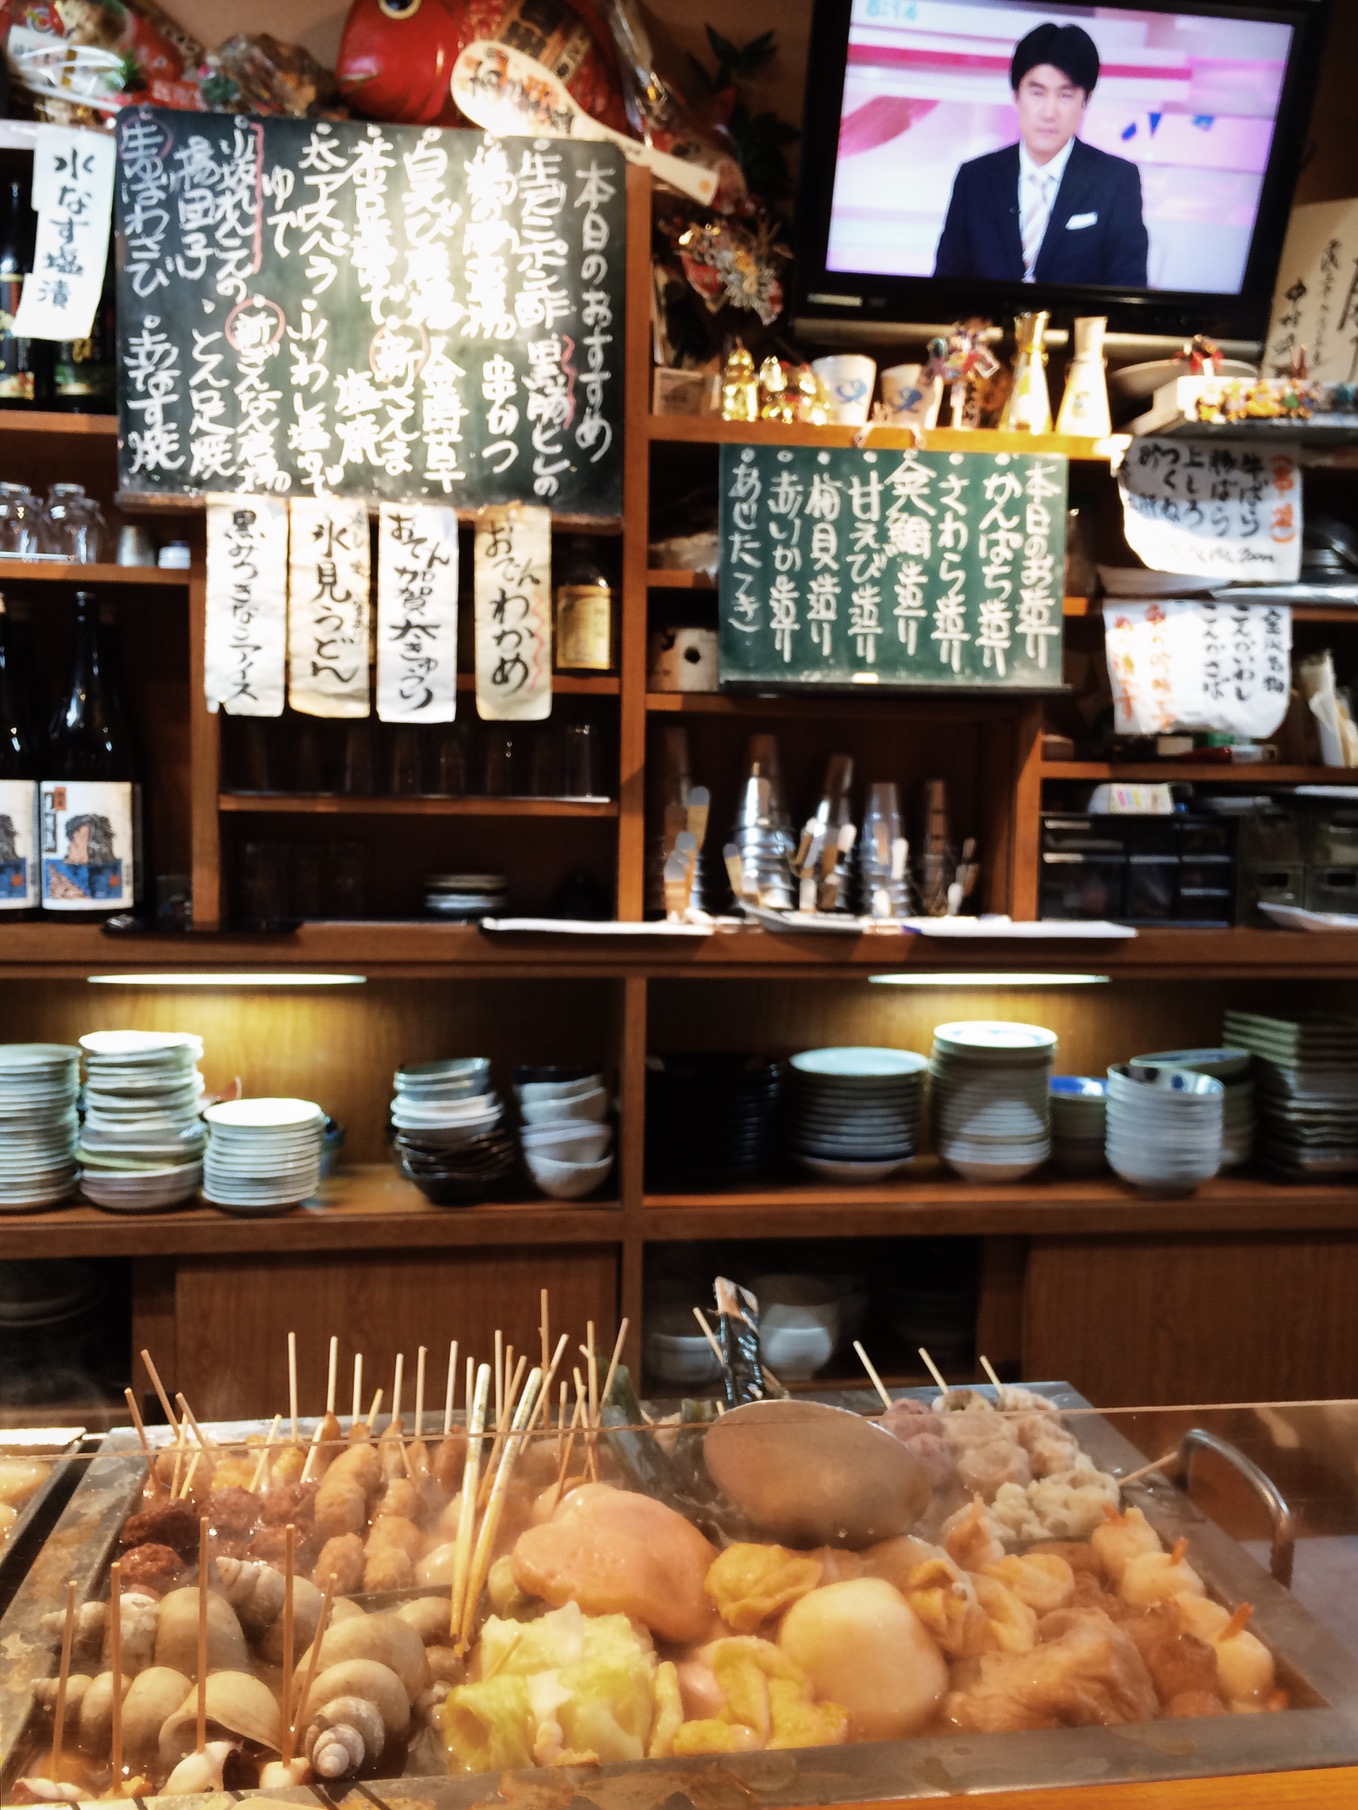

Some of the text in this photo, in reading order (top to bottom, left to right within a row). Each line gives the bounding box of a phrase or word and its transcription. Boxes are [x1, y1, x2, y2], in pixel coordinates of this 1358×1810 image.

[574, 160, 617, 463] 本日のおすすめ
[481, 354, 520, 474] 串かつ
[310, 518, 361, 684] 氷見うどん
[846, 470, 888, 664] 甘えび造り
[931, 473, 971, 673] さわら造り
[974, 471, 1024, 678] かんぱち造り
[1016, 461, 1061, 670] 本日のお造り
